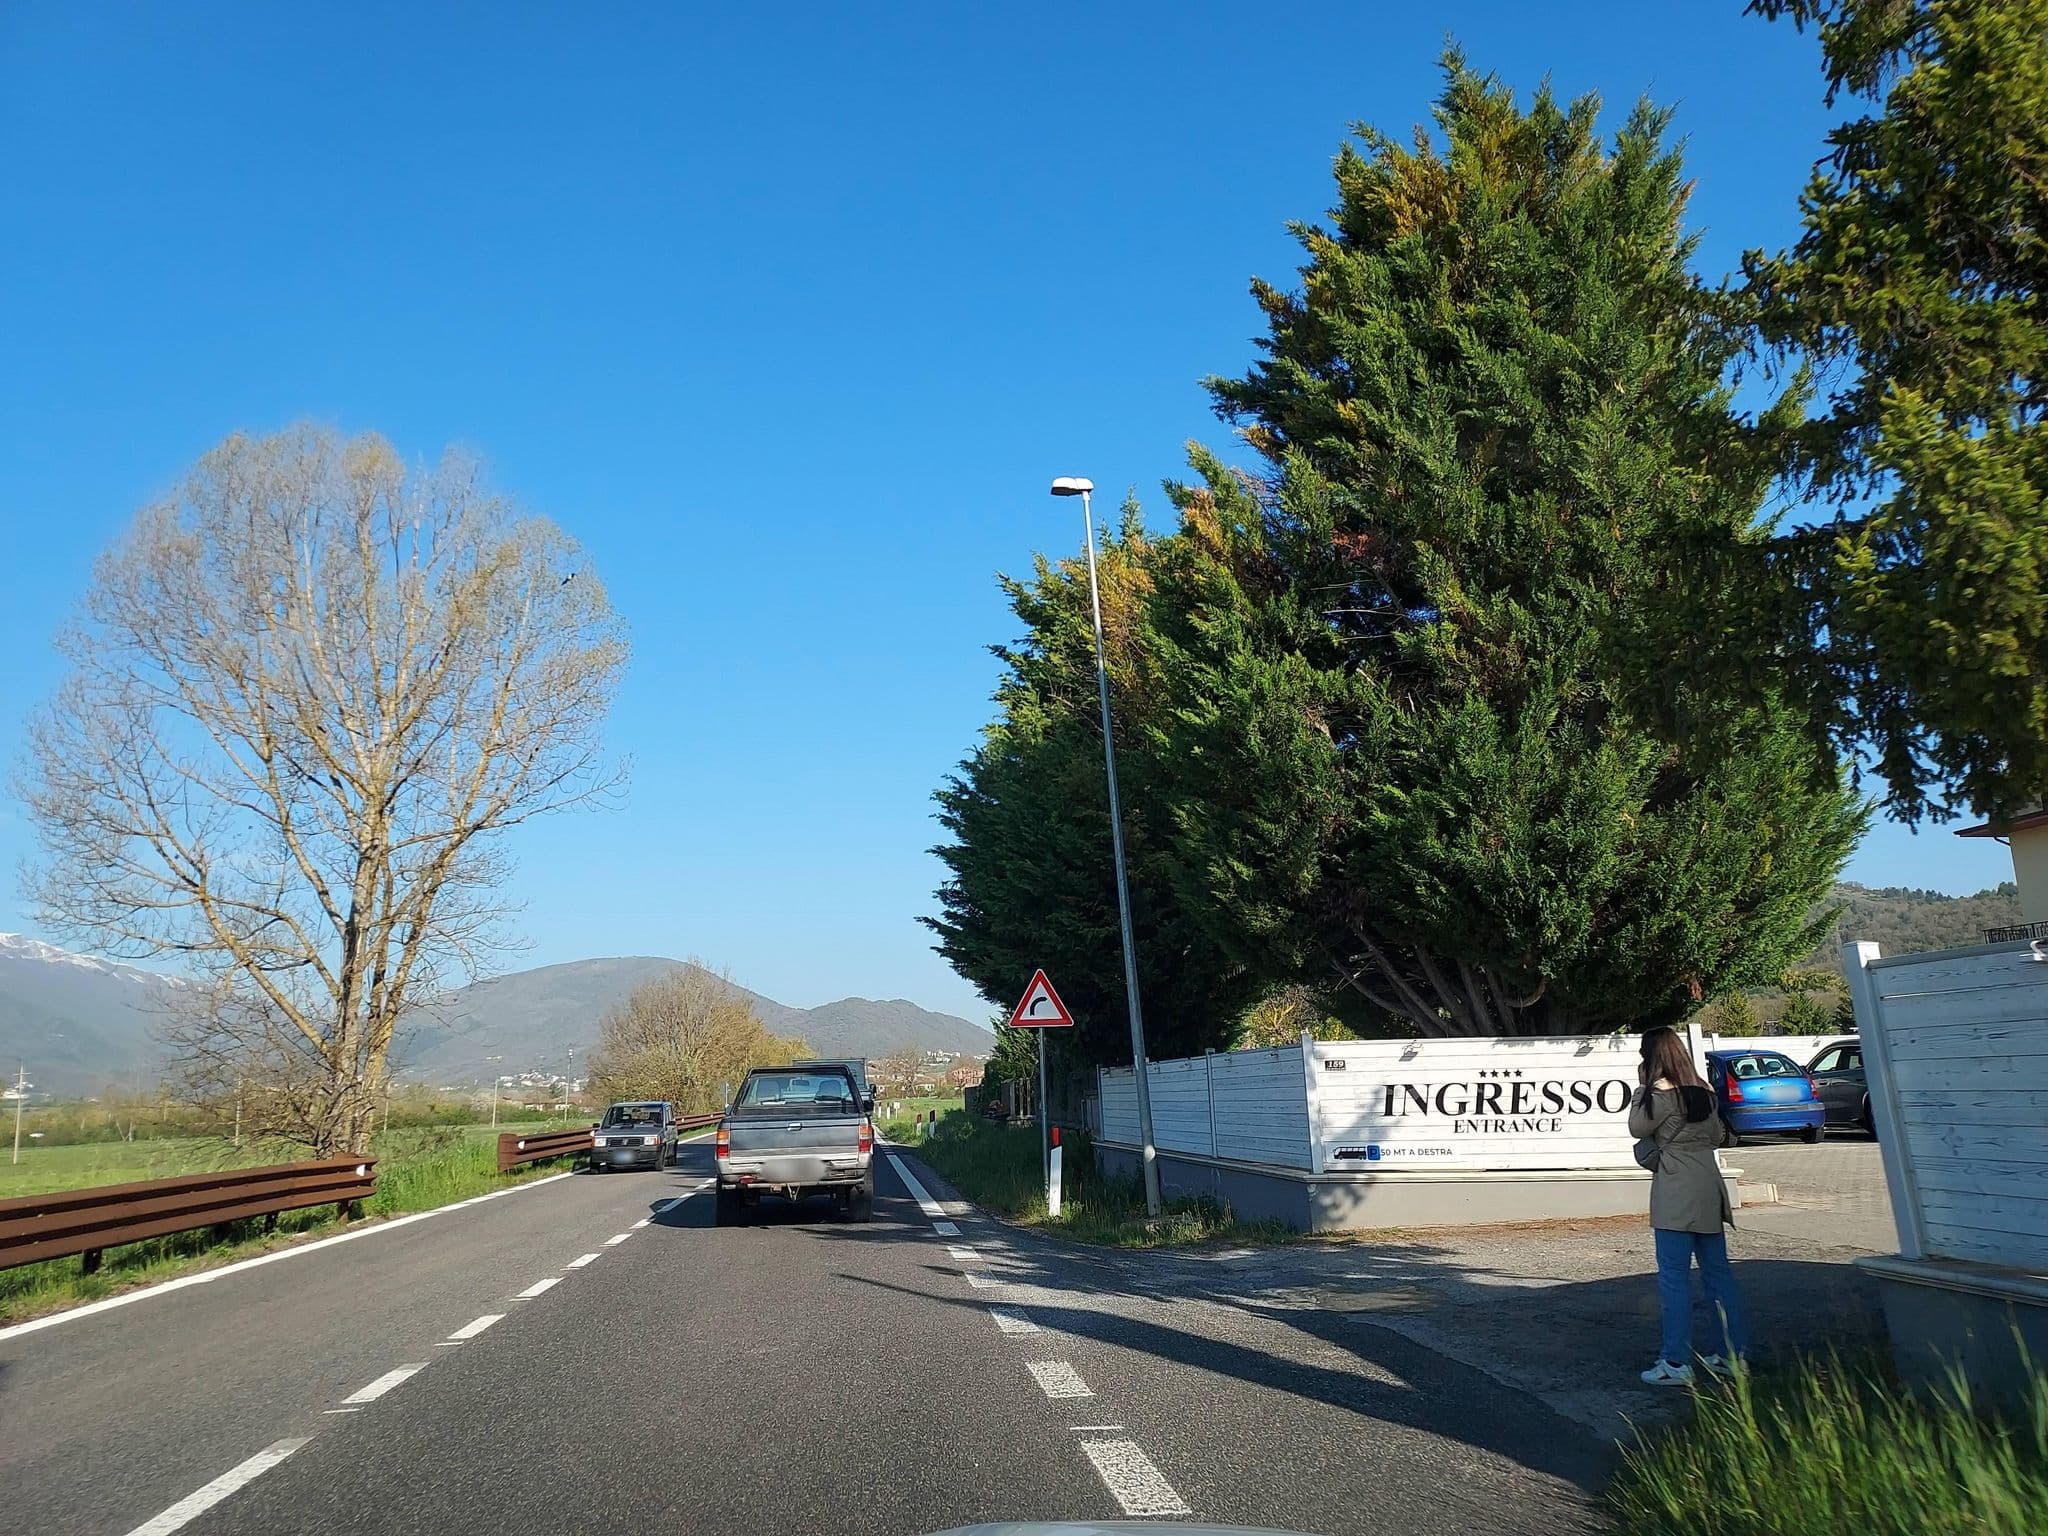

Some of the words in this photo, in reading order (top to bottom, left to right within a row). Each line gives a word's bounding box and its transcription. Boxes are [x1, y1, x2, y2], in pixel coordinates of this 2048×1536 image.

[1381, 1080, 1632, 1116] INGRESSO
[1453, 1118, 1562, 1134] ENTRANCE
[1418, 1148, 1453, 1156] DESTRA
